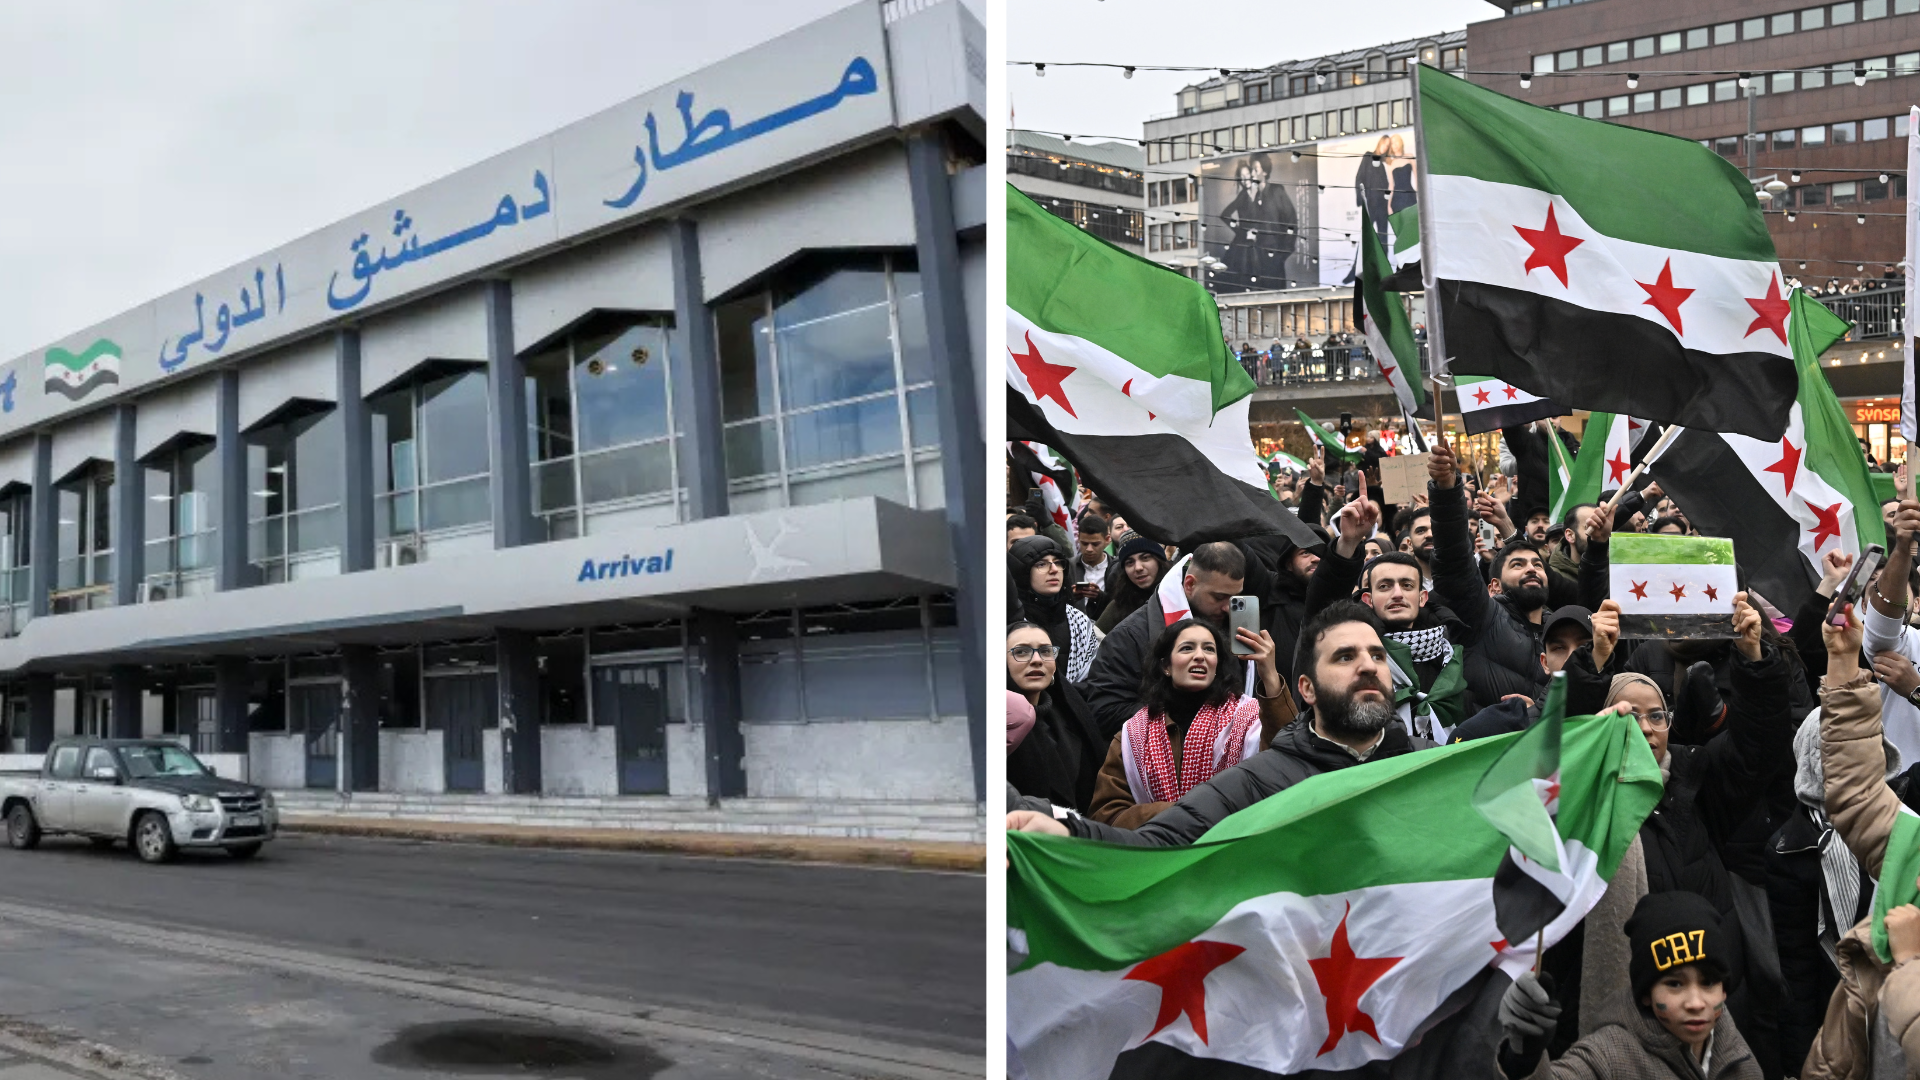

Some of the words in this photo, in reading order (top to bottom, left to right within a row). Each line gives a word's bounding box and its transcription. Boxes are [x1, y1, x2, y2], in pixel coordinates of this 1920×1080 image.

[159, 262, 287, 374] الدولي
[577, 547, 674, 583] Arrival
[1650, 929, 1706, 972] CR7
